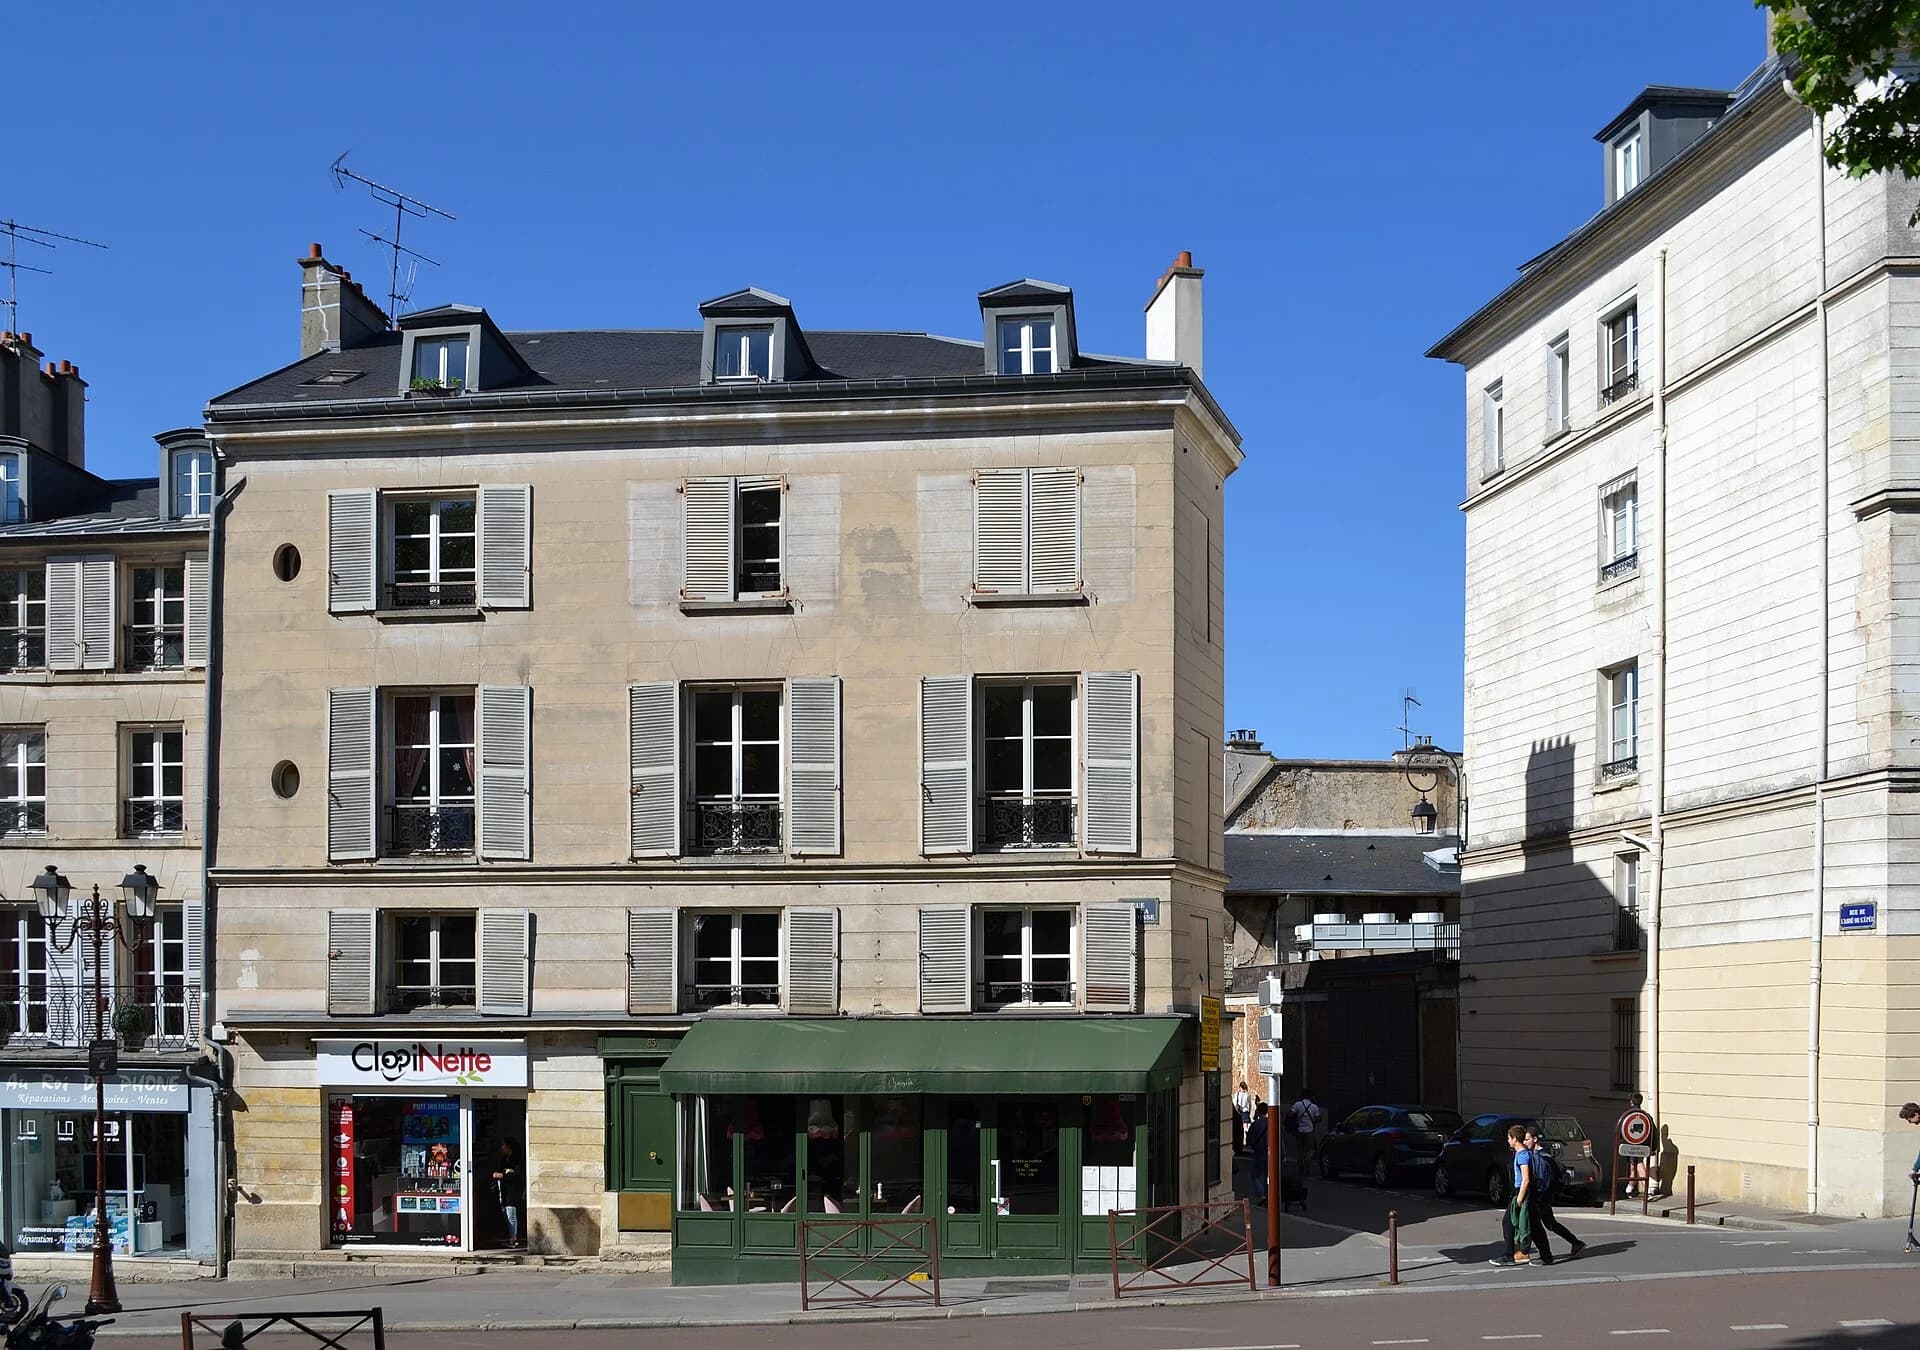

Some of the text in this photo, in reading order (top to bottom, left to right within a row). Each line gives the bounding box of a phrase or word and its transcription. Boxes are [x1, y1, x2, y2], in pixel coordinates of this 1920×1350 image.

[351, 1041, 492, 1074] ClopiNette
[119, 1074, 179, 1093] PHONE
[80, 1094, 129, 1104] Accsoires
[138, 1094, 169, 1105] Ventes
